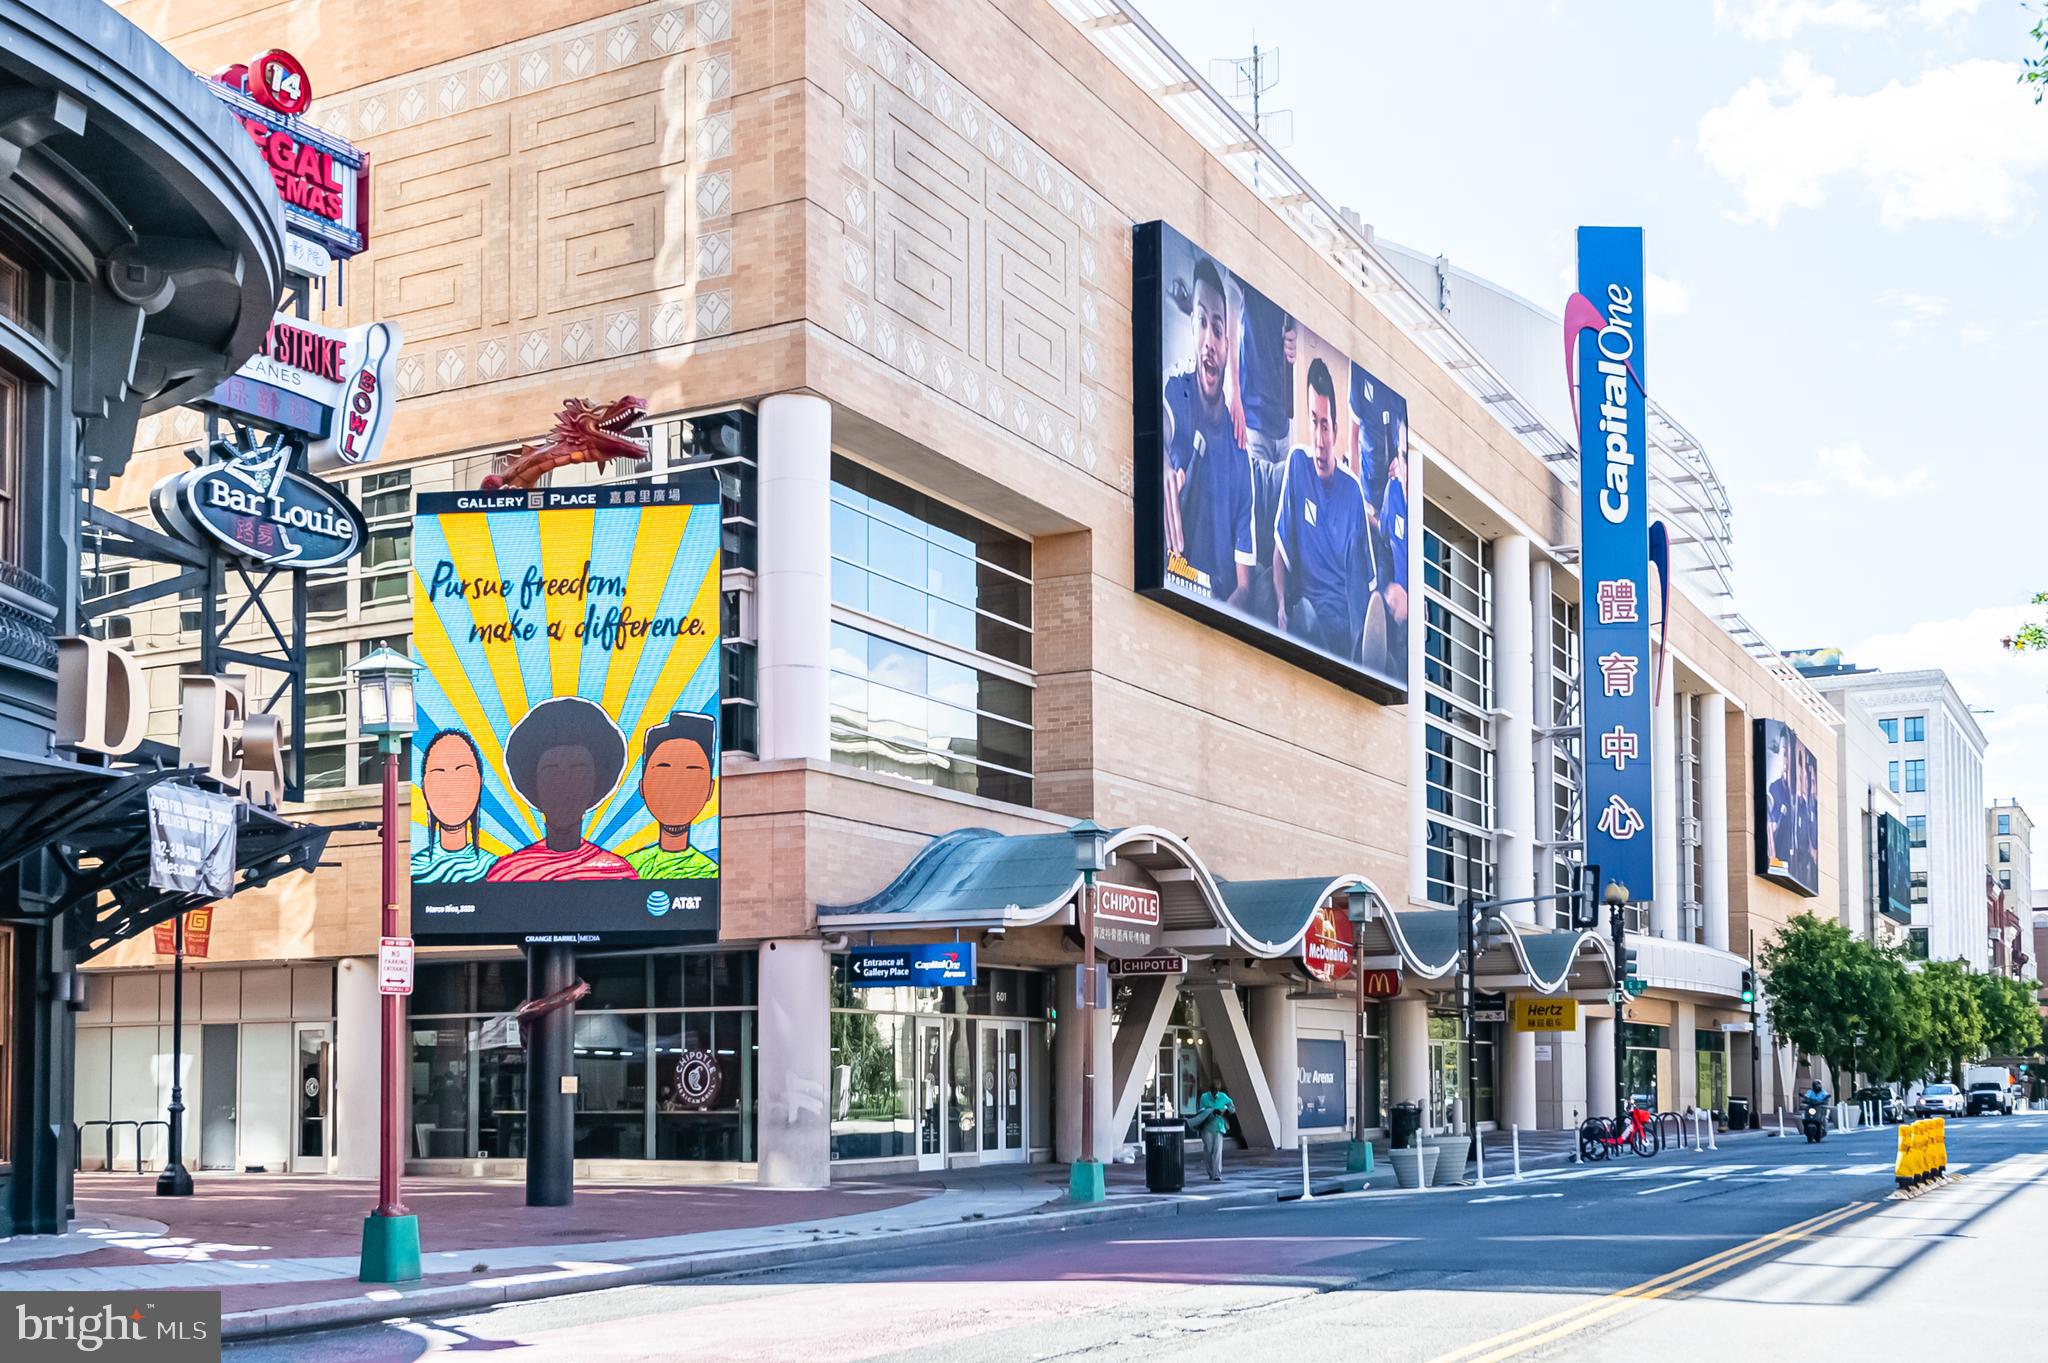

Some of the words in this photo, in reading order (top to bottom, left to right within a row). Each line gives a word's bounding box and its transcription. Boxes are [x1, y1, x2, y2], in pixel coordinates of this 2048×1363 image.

[271, 62, 301, 100] 14
[238, 114, 343, 194] EGAL
[279, 322, 347, 384] STRIKE
[344, 369, 377, 459] BOWL
[208, 478, 266, 517] Bar
[270, 495, 353, 541] Louie
[457, 496, 524, 509] GALLERY
[550, 493, 597, 506] PLACE
[429, 559, 514, 602] Pursue
[520, 559, 627, 609] freedom,
[469, 608, 538, 644] make
[546, 618, 566, 642] a
[574, 603, 706, 651] difference.
[1597, 578, 1645, 841] 體育中心
[672, 896, 702, 910] AT&T
[1101, 891, 1157, 916] CHIPOTLE
[863, 958, 895, 967] Entrance
[895, 958, 904, 966] at
[1309, 943, 1348, 963] McDonald's
[863, 967, 889, 978] Gallery
[889, 966, 910, 976] Place
[943, 970, 966, 978] Arena
[1123, 960, 1179, 971] CHIPOTLE
[996, 991, 1007, 1001] 601
[1527, 1004, 1564, 1016] Hertz
[676, 1051, 717, 1074] CHIPOTLE
[1312, 1070, 1334, 1084] Arena
